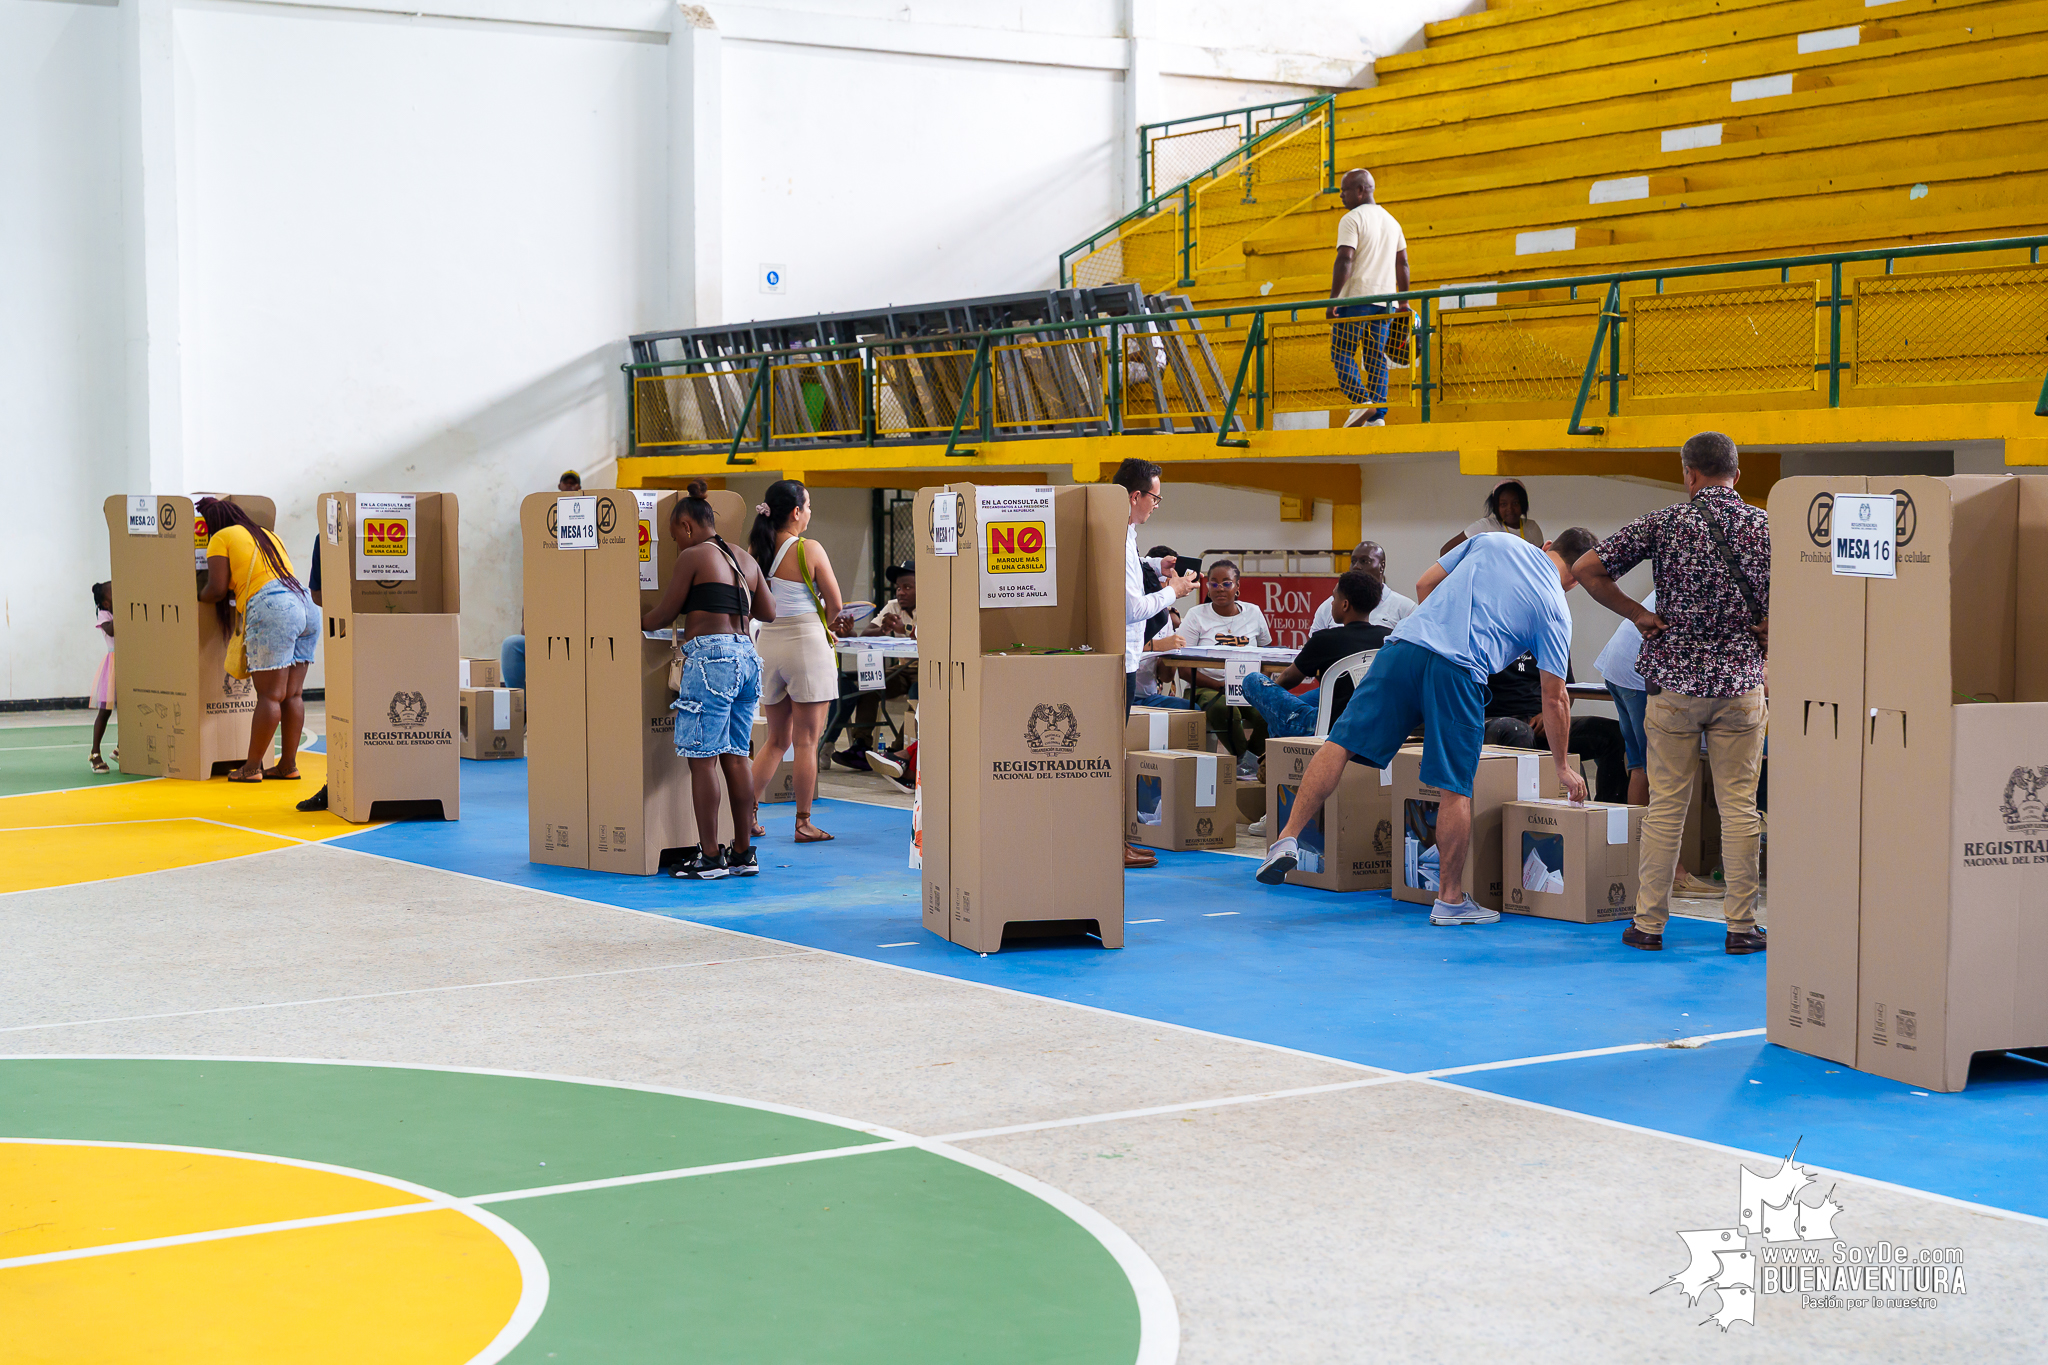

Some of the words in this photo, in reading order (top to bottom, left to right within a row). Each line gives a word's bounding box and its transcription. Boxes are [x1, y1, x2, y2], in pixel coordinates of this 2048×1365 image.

[130, 516, 146, 526] MESA
[147, 516, 155, 526] 20
[368, 523, 406, 542] NO
[561, 526, 581, 538] MESA
[583, 525, 593, 538] 18
[935, 526, 948, 542] MESA
[948, 527, 954, 542] 17
[609, 536, 626, 544] celular
[992, 527, 1043, 554] NO
[1837, 538, 1870, 559] MESA
[1874, 540, 1890, 560] 16
[1800, 551, 1832, 563] Prohibid
[1904, 552, 1930, 563] celular
[1298, 619, 1310, 629] DE
[860, 671, 874, 681] MESA
[875, 670, 882, 680] 19
[1228, 684, 1242, 696] MES
[206, 700, 256, 710] REGISTRADU
[364, 729, 452, 740] REGISTRADURÍA
[1283, 746, 1315, 756] CONSULTAS
[993, 756, 1111, 772] REGISTRADURÍA
[1140, 760, 1158, 771] CÁMARA
[1528, 814, 1558, 826] CÁMARA
[1964, 840, 2048, 856] REGISTRA
[1352, 860, 1392, 869] REGISTR
[1963, 857, 2009, 867] NACIONAL
[2012, 856, 2030, 864] DEL
